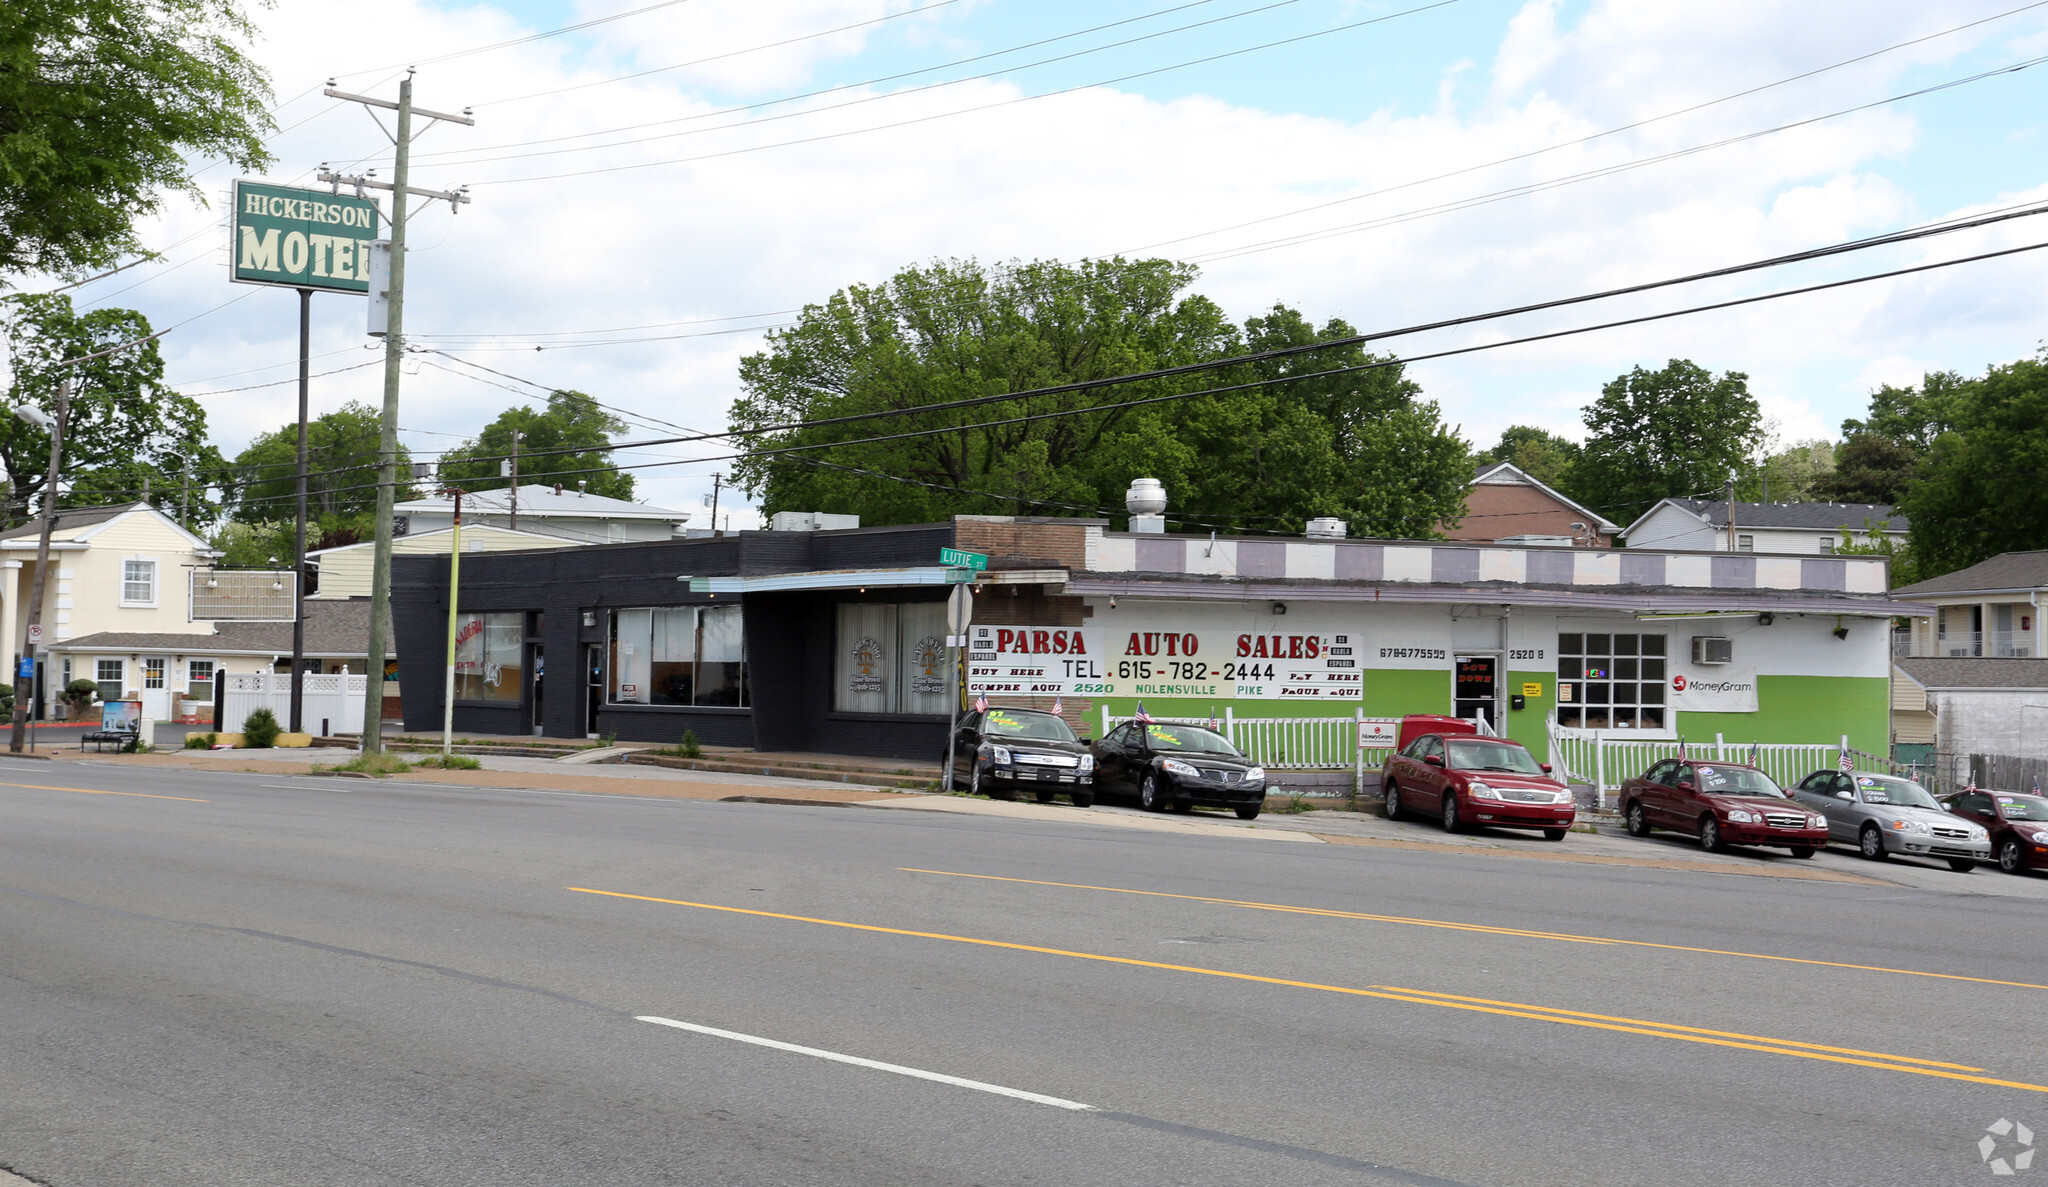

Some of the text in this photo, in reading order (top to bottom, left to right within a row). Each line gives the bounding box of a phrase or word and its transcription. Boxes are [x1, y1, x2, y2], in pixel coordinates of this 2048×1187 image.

[245, 193, 371, 229] HICKERSON
[943, 550, 972, 566] LUTIE
[997, 629, 1320, 660] PARSA AUTO SALES
[1510, 650, 1534, 659] 2520
[1586, 669, 1605, 677] OPEN
[1074, 684, 1263, 695] 2520 NOLENSVILLE PIKE
[1689, 681, 1752, 693] MoneyGram
